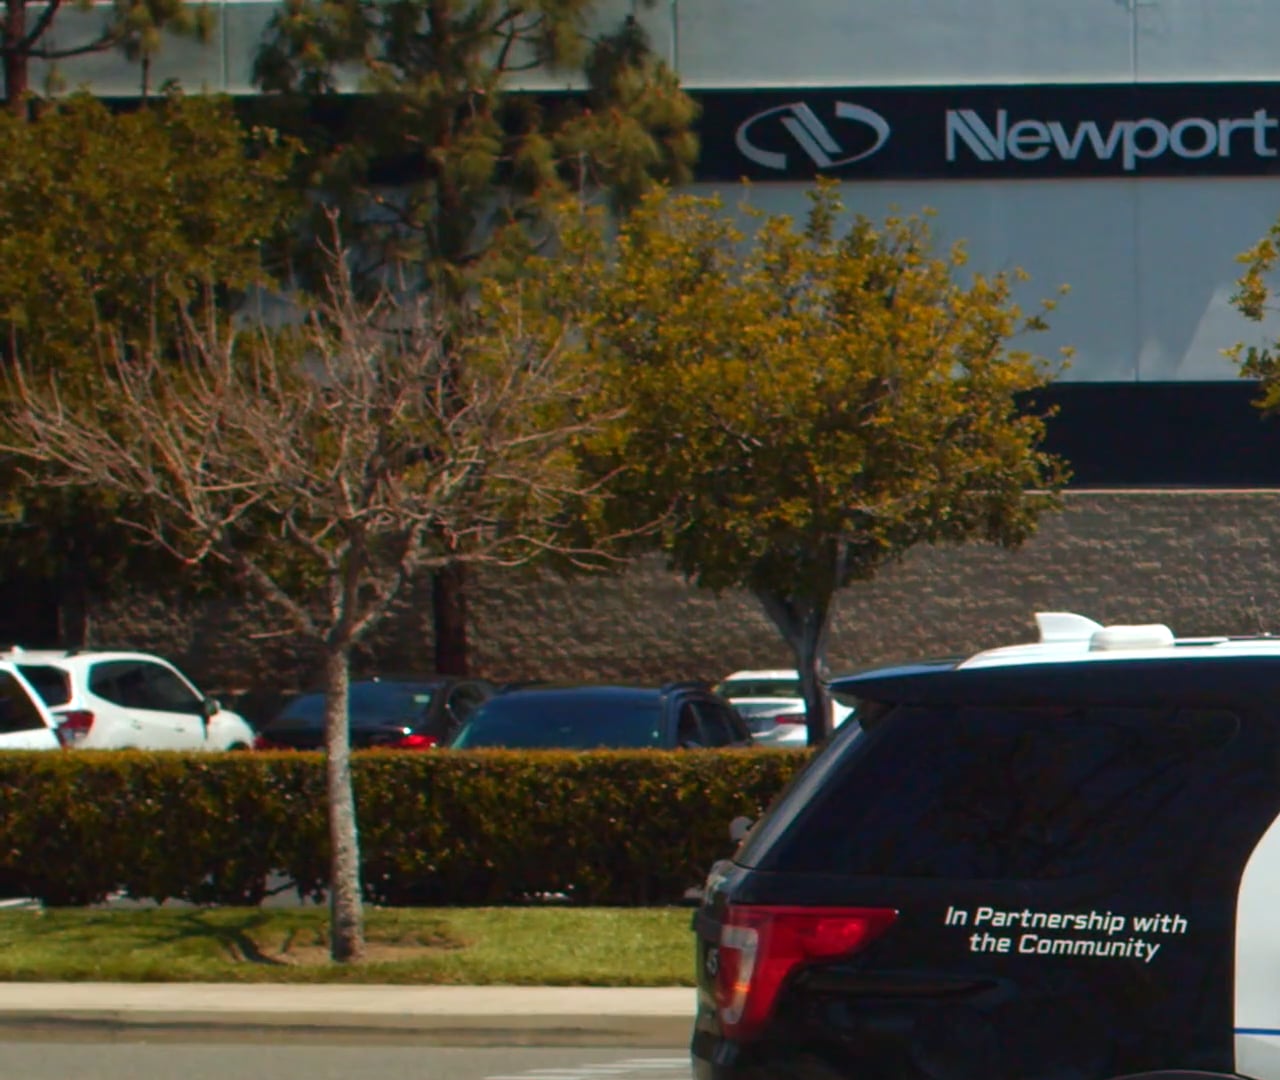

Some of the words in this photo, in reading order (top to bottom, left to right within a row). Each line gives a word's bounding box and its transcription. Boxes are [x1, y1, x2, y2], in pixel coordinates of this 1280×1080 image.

[945, 108, 1278, 170] Newport
[944, 906, 968, 925] In
[974, 907, 1126, 935] Partnership
[1133, 912, 1188, 934] with
[969, 932, 1011, 952] the
[1018, 934, 1160, 962] Community
